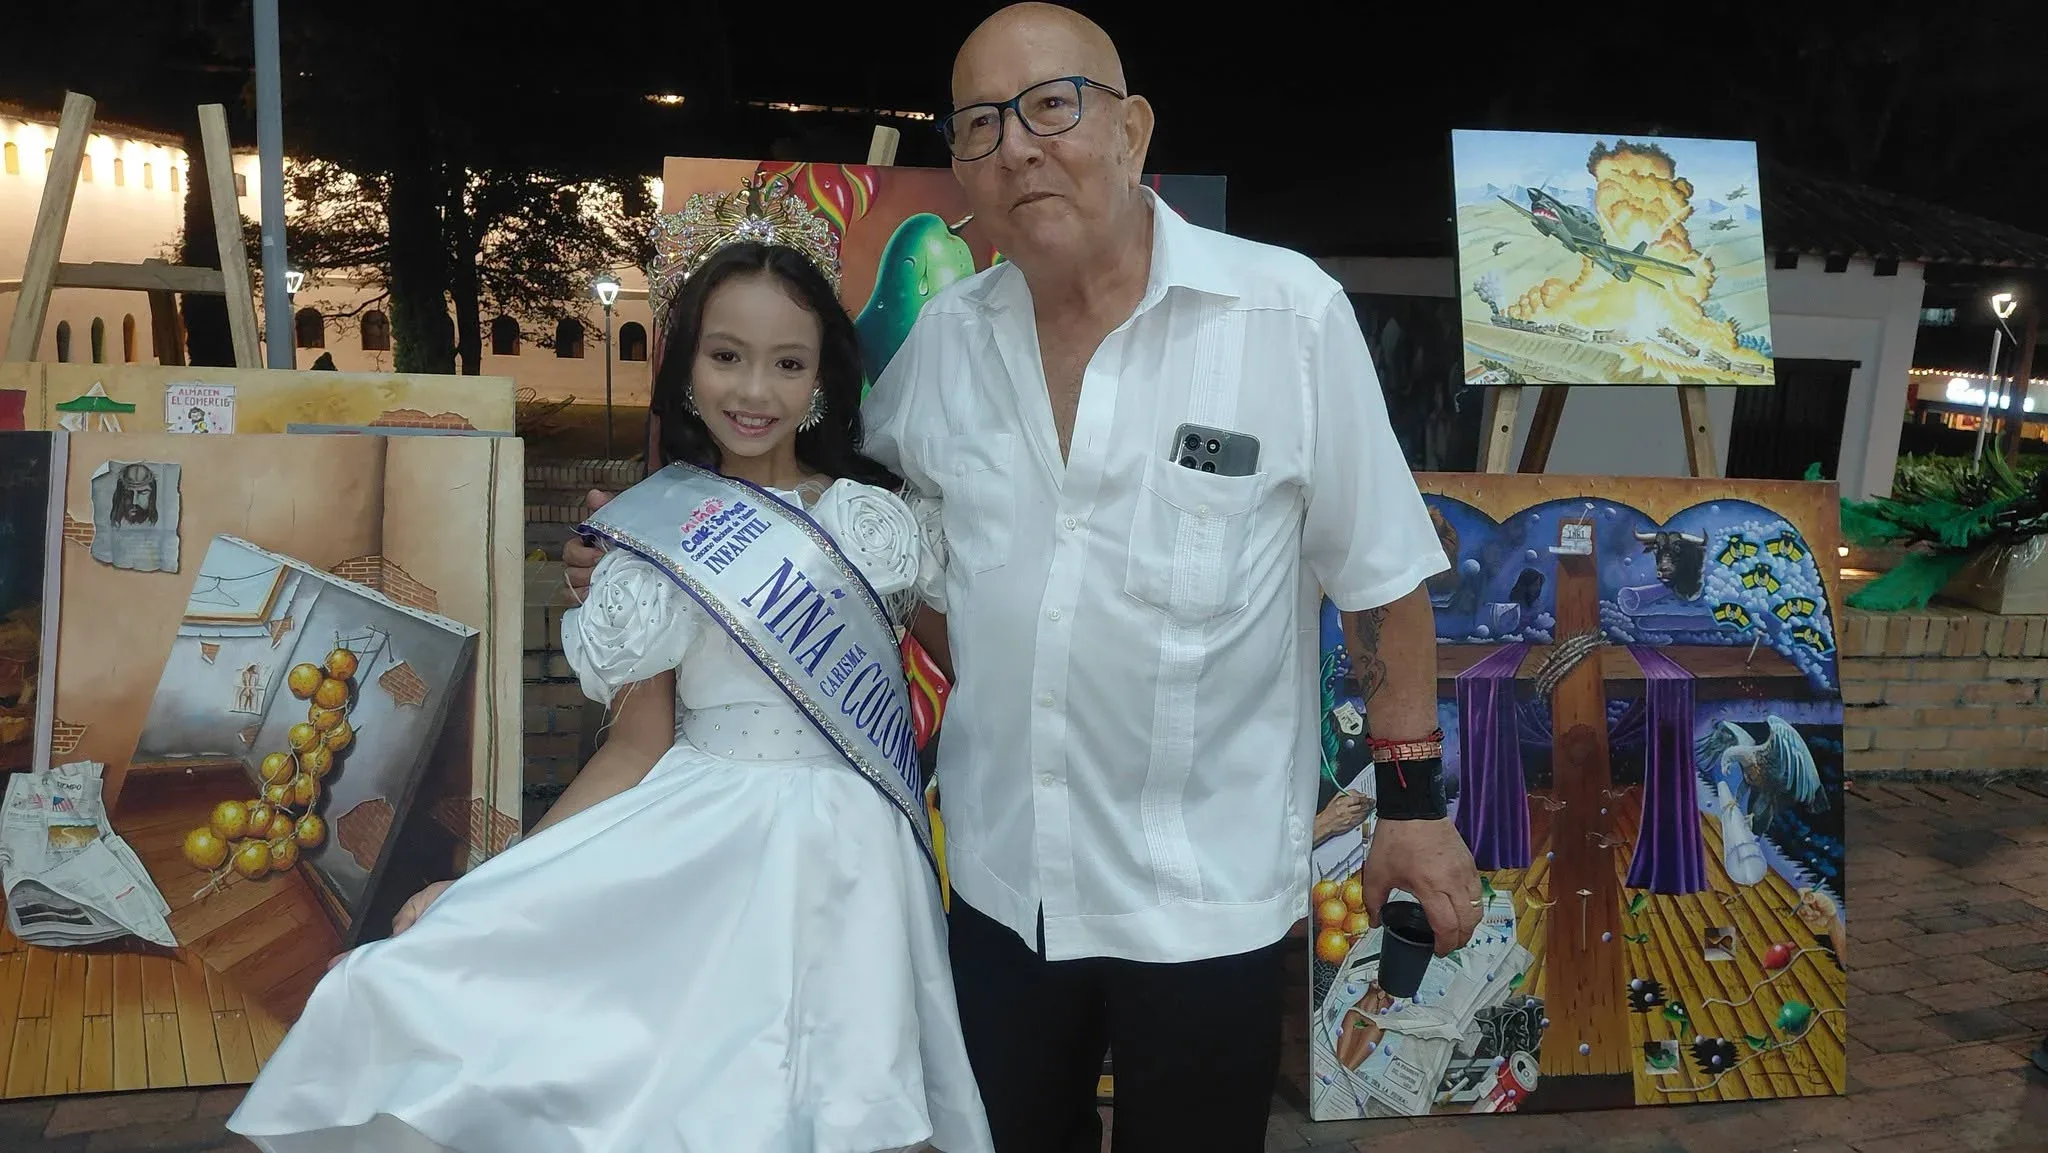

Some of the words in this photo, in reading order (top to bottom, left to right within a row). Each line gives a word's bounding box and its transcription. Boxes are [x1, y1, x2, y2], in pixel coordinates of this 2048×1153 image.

[703, 517, 772, 575] INFANTIL
[741, 556, 846, 678] NIÑA
[819, 643, 867, 698] CARISMA
